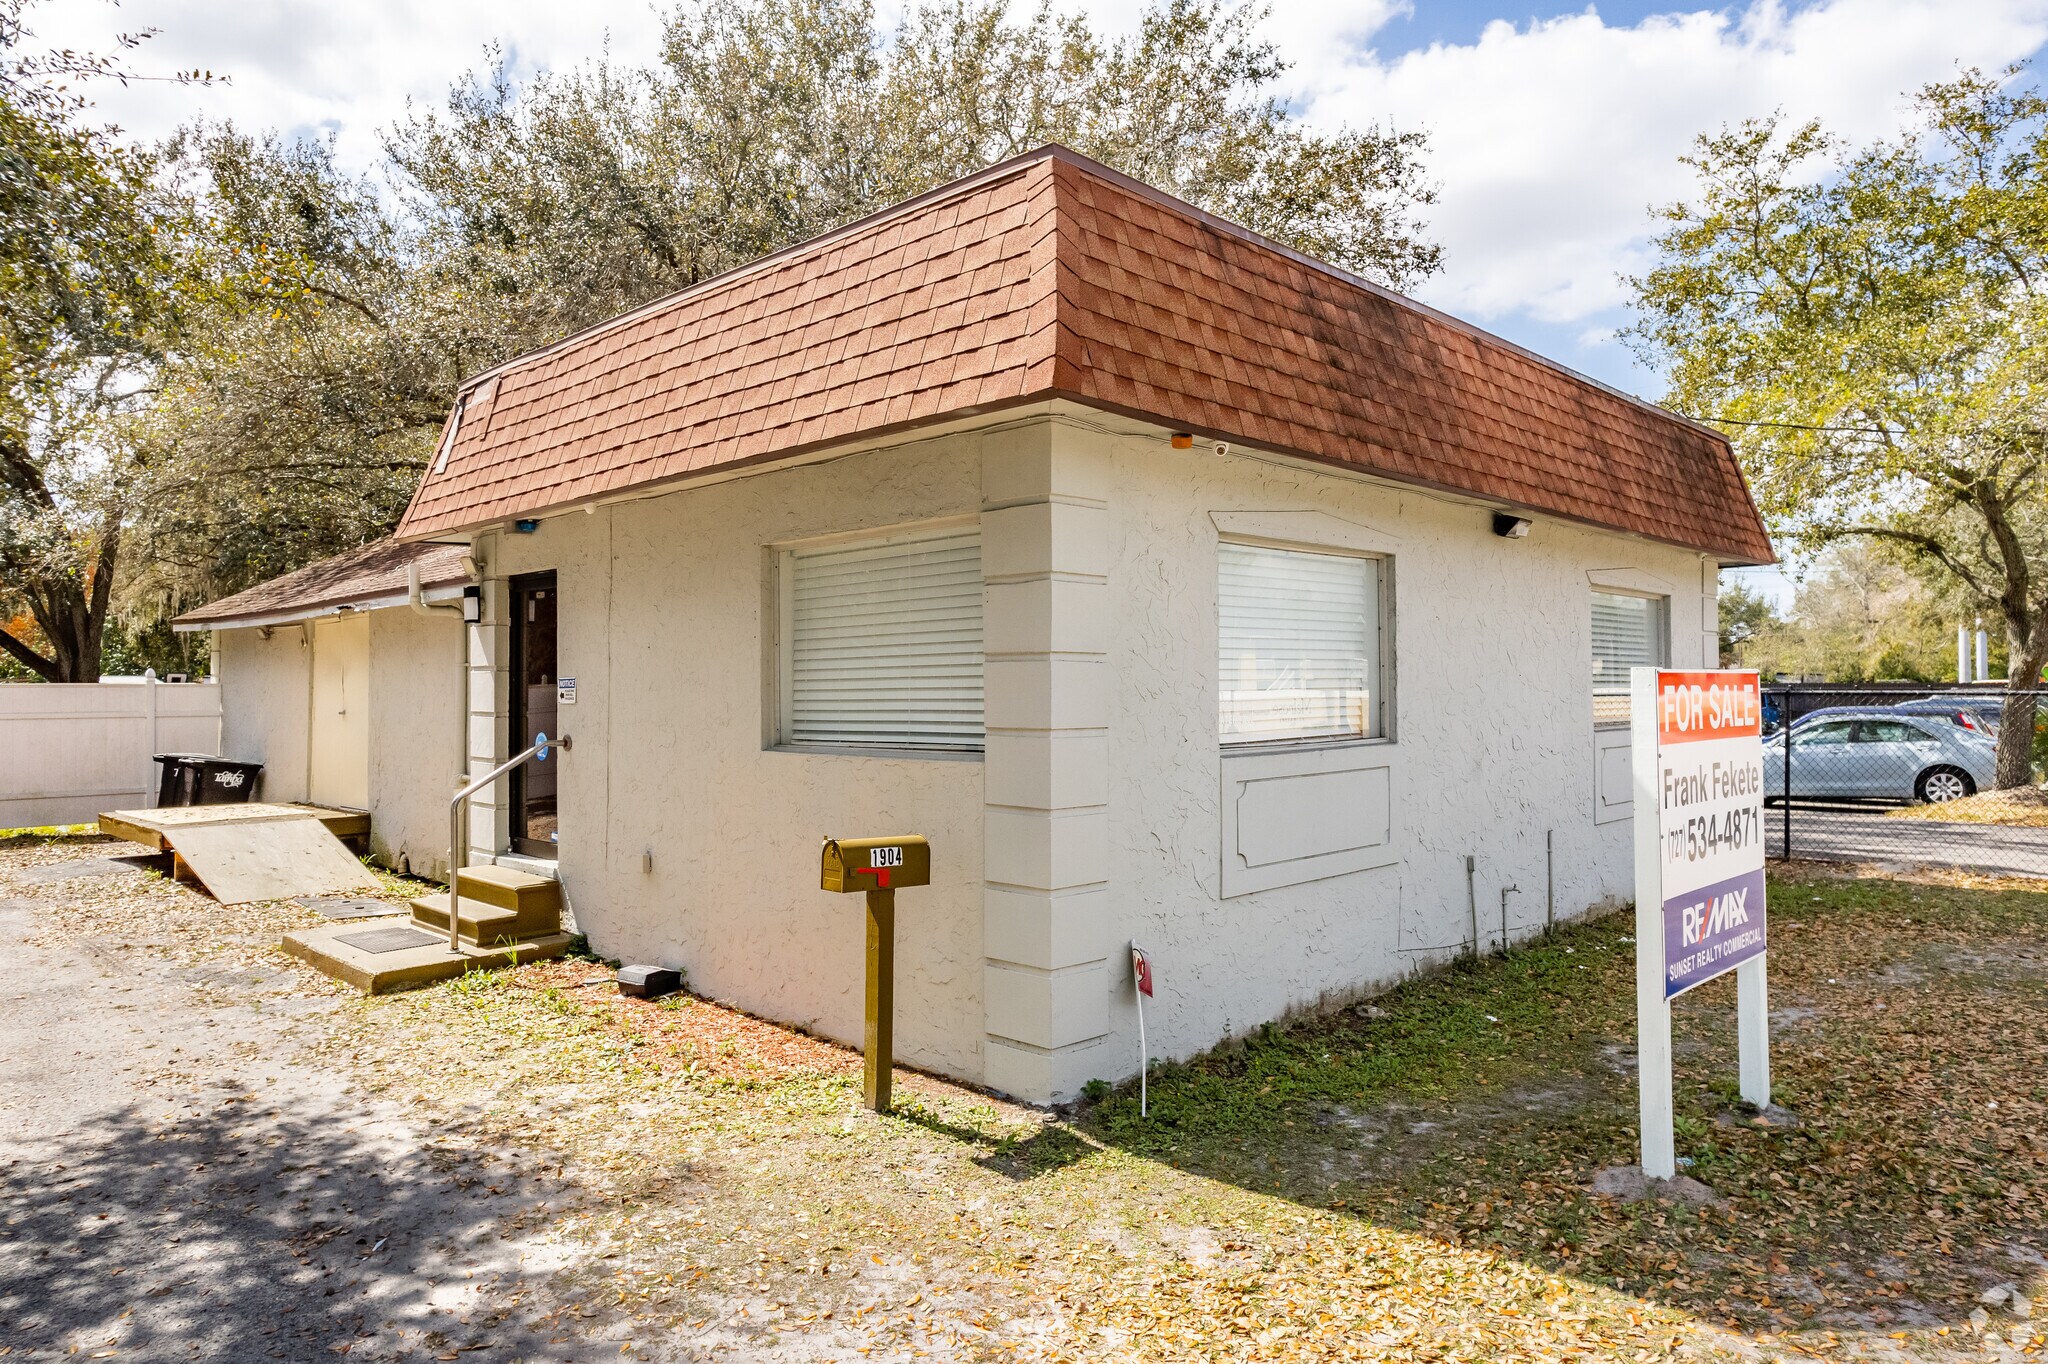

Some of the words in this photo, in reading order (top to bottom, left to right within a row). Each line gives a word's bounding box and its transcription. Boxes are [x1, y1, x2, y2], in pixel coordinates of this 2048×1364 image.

[559, 679, 575, 687] NOTICE
[1664, 684, 1704, 733] FOR
[1709, 684, 1755, 730] SALE
[214, 769, 245, 788] Tampa
[1664, 764, 1708, 809] Frank
[1712, 760, 1759, 800] Fekete
[872, 847, 902, 867] 1904
[1668, 824, 1686, 864] (727)
[1688, 805, 1758, 862] 534-4871
[1682, 886, 1749, 948] RE/MAX
[1669, 954, 1696, 982] SUNSET
[1696, 943, 1722, 969] REALTY
[1723, 927, 1762, 956] COMMERCIAL
